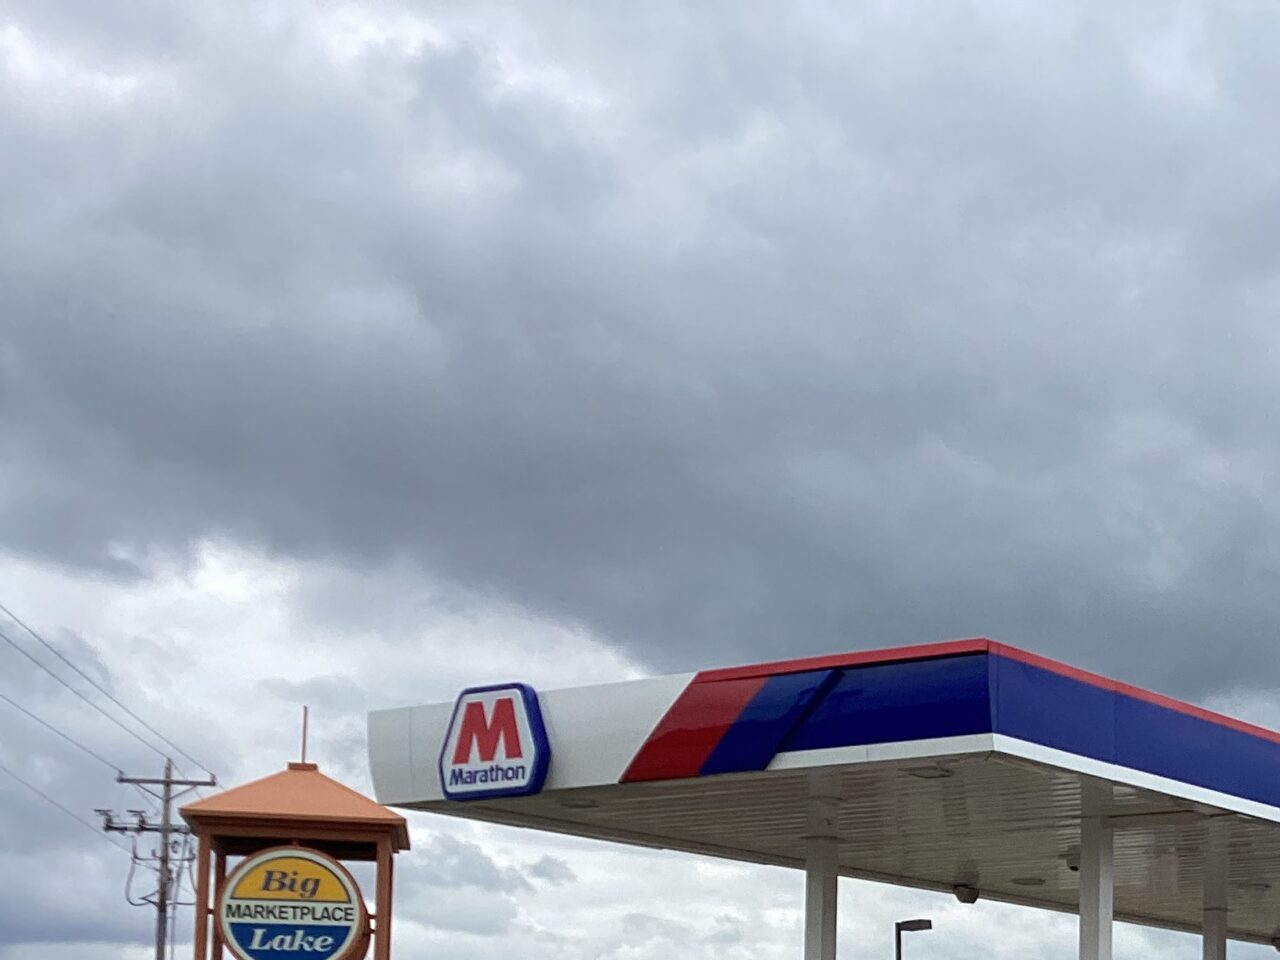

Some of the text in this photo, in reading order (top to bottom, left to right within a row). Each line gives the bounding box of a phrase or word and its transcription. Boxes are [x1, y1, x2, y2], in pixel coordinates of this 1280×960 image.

[452, 698, 523, 765] M
[449, 764, 525, 786] Marathon
[261, 870, 321, 898] Big
[225, 903, 355, 922] MARKETPLACE
[248, 928, 335, 952] Lake
